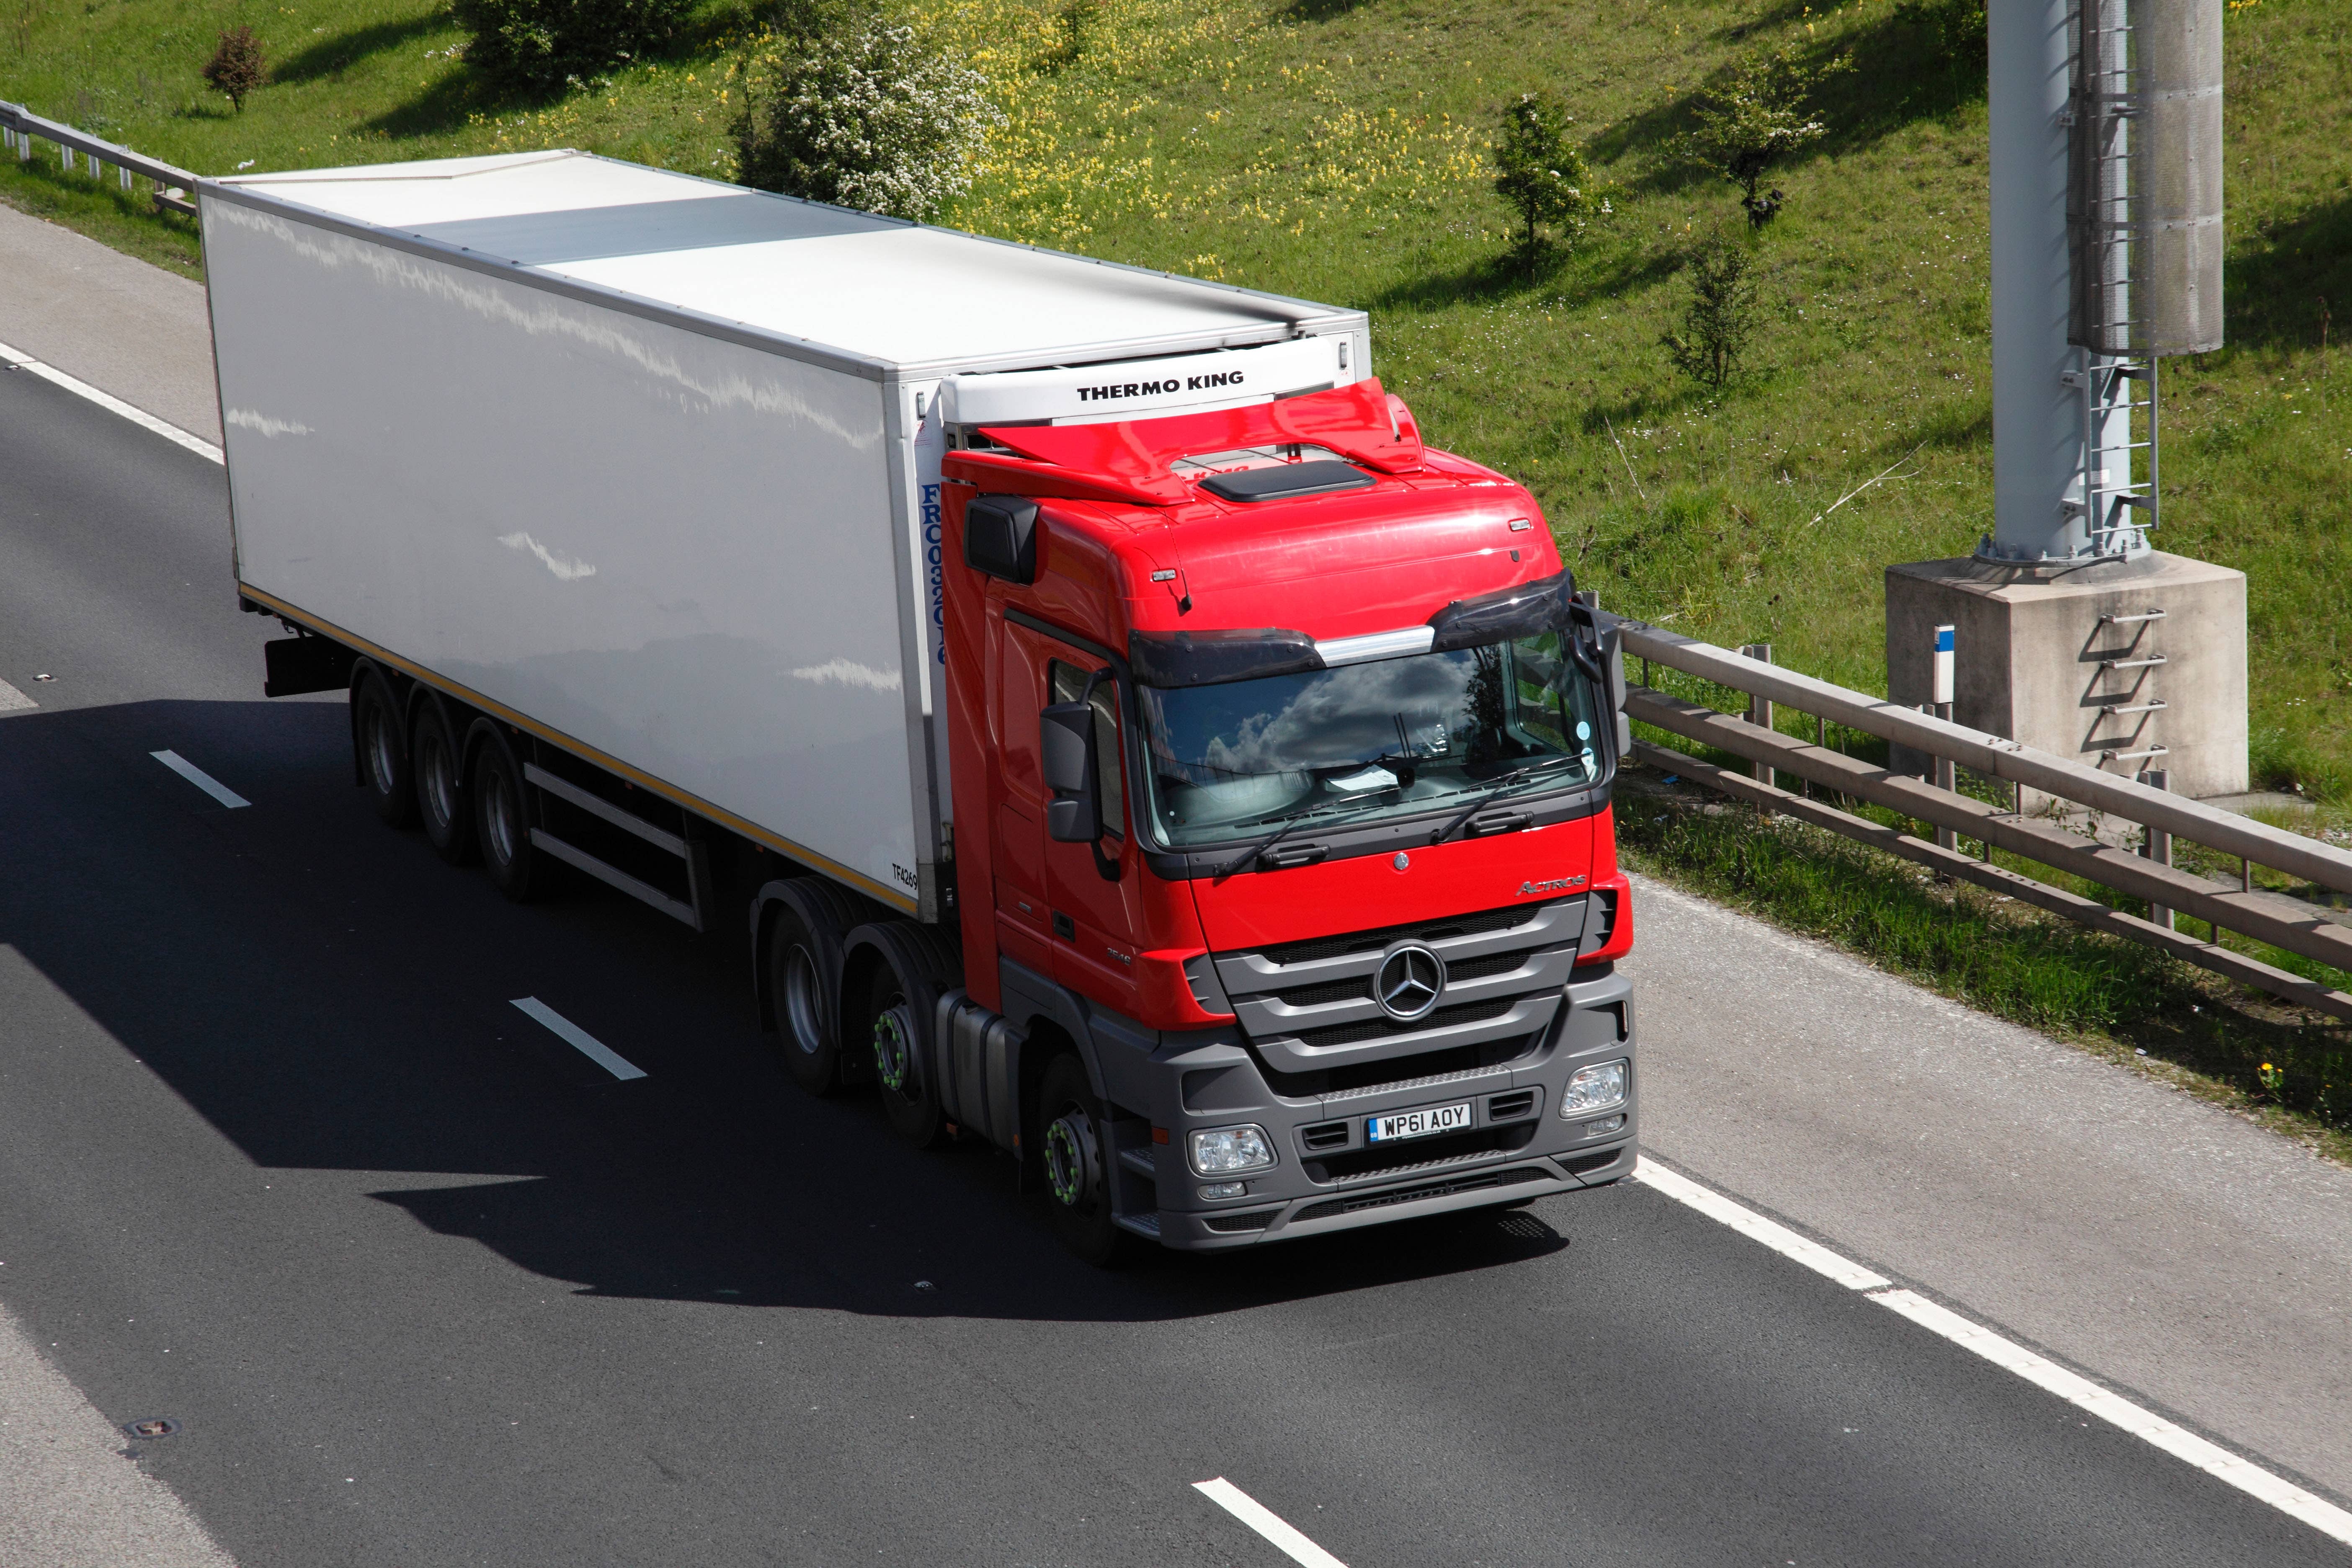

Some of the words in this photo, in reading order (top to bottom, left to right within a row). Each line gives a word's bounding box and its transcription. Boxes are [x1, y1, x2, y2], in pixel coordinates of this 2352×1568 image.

[1077, 379, 1180, 401] THERMO
[1187, 371, 1244, 390] KING
[892, 863, 918, 890] TF4269
[1384, 1113, 1424, 1136] WP61
[1431, 1106, 1464, 1129] AOY
